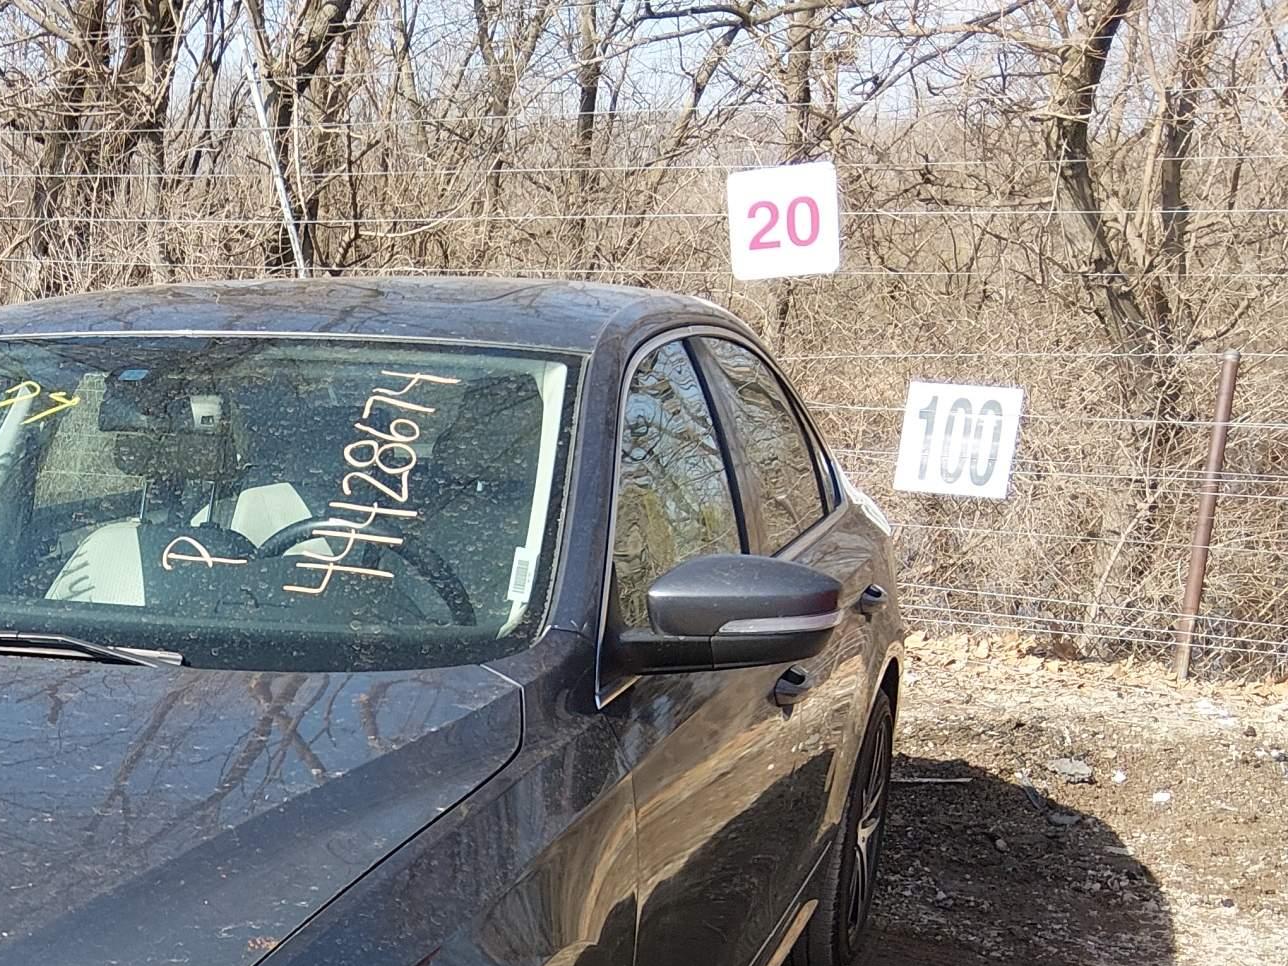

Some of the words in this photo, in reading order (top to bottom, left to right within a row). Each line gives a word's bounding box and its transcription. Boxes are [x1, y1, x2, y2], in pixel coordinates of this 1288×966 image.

[747, 196, 821, 251] 20
[282, 369, 461, 595] 44428674
[918, 394, 1003, 488] 100
